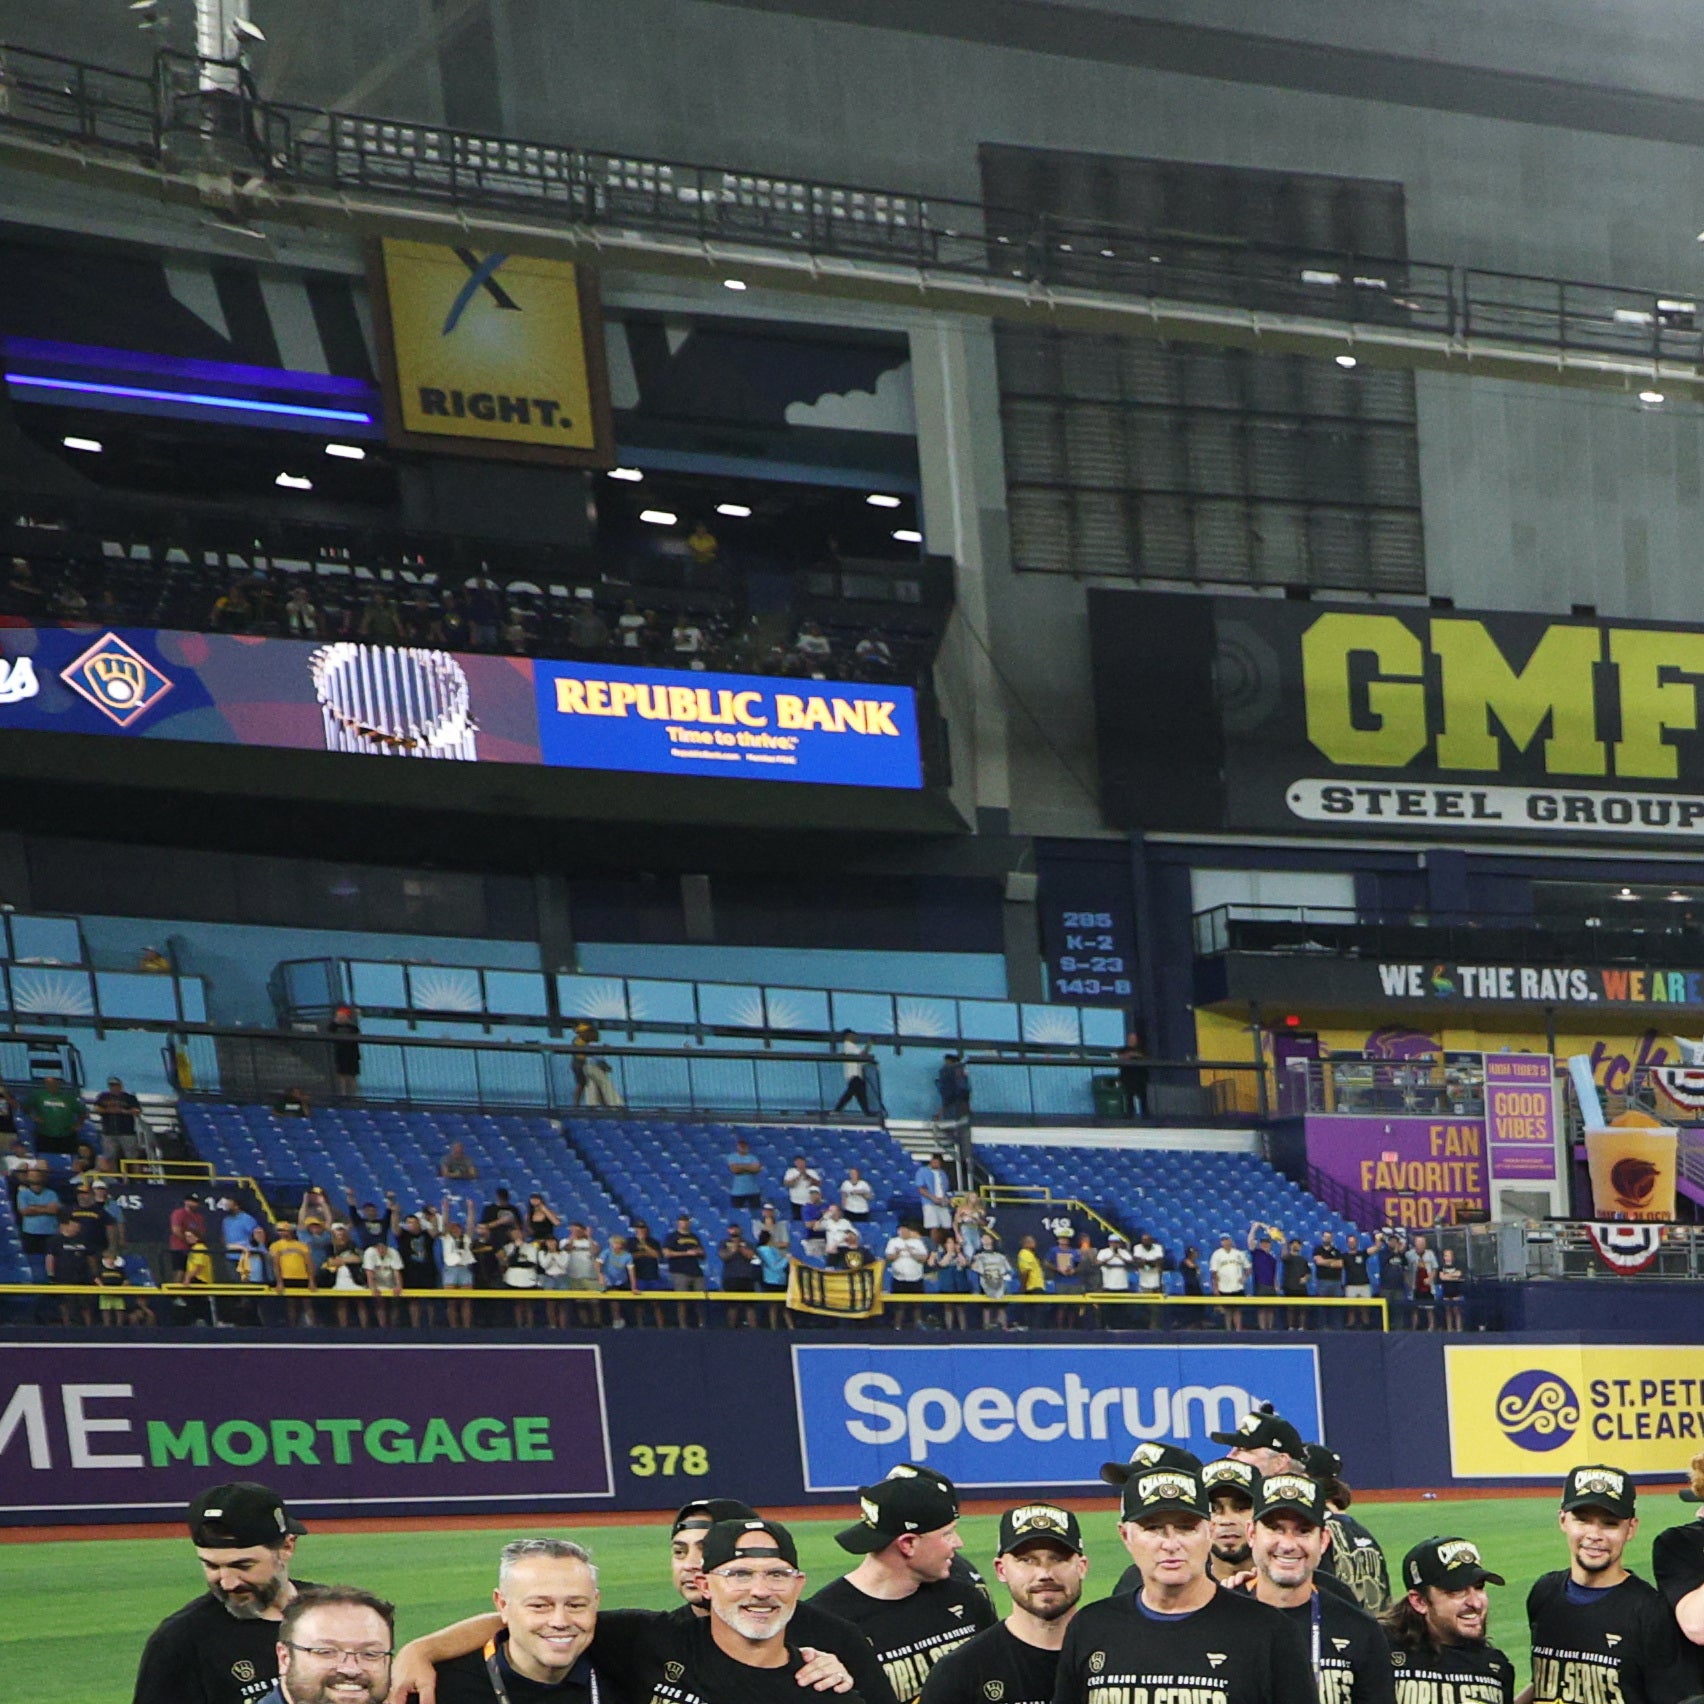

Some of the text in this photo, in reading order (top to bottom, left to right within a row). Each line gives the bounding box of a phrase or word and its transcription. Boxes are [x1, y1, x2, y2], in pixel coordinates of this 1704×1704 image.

[419, 387, 573, 431] RIGHT.
[554, 678, 900, 736] REPUBLIC BANK
[1320, 788, 1501, 822] STEEL
[1379, 965, 1425, 998] WE
[1456, 966, 1515, 999] THE
[1520, 967, 1598, 1002] RAYS.
[1601, 969, 1646, 1003] WE
[1651, 971, 1701, 1003] ARE
[1494, 1092, 1546, 1117] GOOD
[1430, 1126, 1480, 1156] FAN
[1496, 1118, 1547, 1140] VIBES
[1361, 1159, 1480, 1194] FAVORITE
[1589, 1379, 1636, 1408] ST.
[843, 1372, 1262, 1462] Spectrum
[145, 1416, 554, 1469] MORTGAGE
[629, 1445, 710, 1477] 378
[1138, 1470, 1199, 1500] CHAMPIONS
[1262, 1476, 1317, 1503] CHAMPIONS
[1574, 1471, 1624, 1494] CHAMPIONS
[1012, 1508, 1069, 1531] CHAMPIONS
[1107, 1675, 1228, 1689] MAJOR LEAGUE BASEBALL
